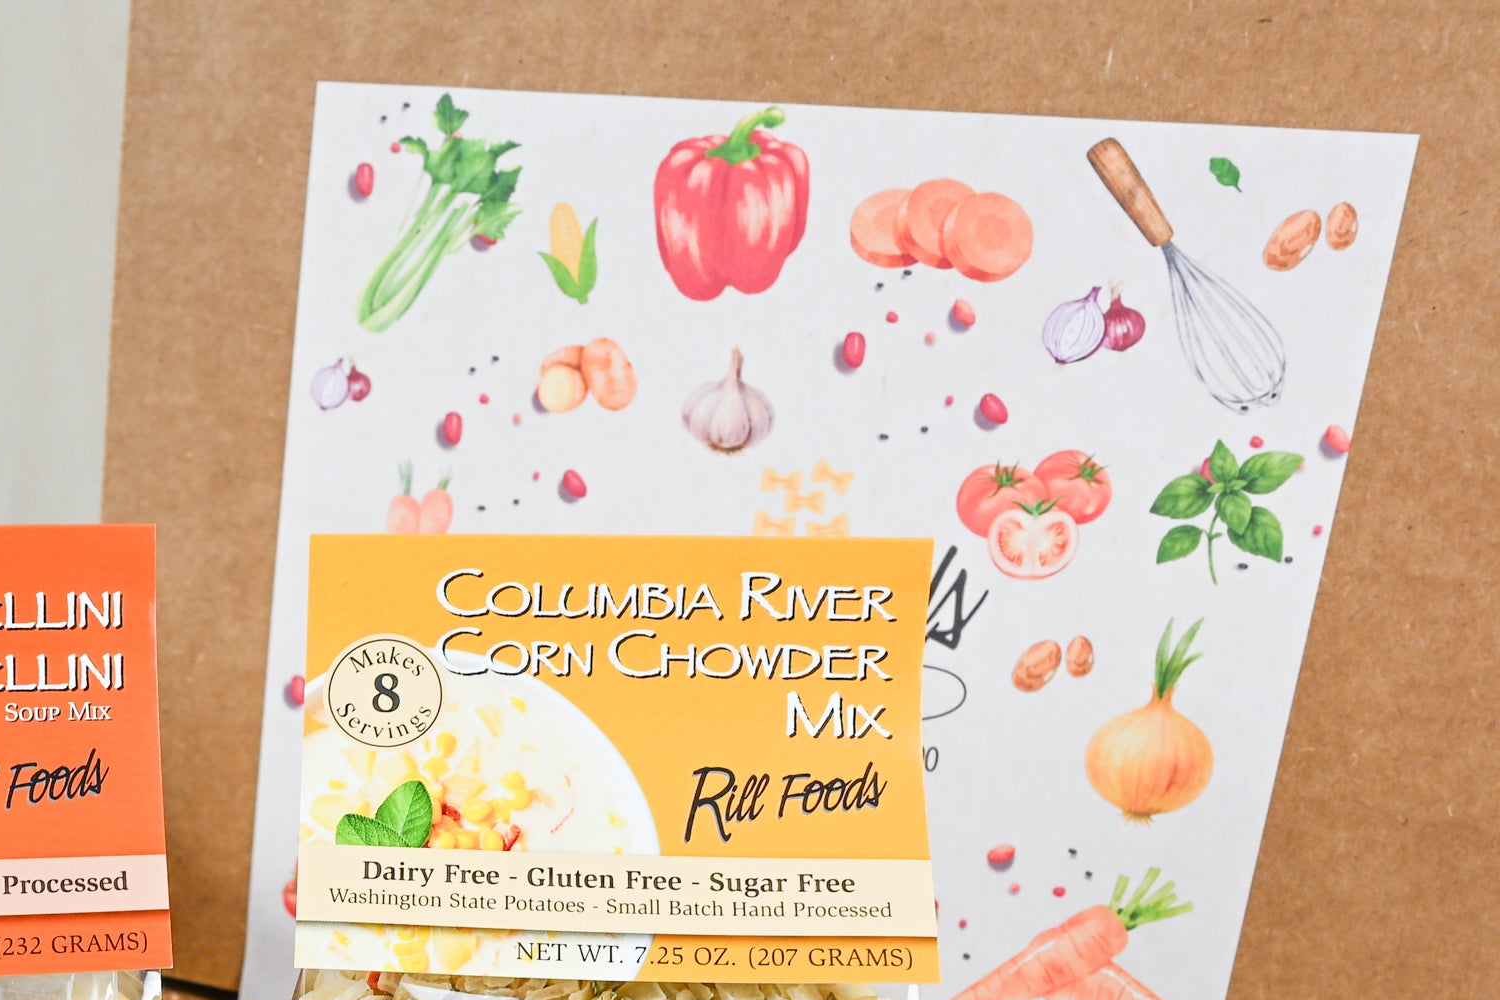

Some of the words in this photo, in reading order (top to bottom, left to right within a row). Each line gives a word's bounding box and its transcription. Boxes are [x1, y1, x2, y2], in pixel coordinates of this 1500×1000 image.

[436, 568, 723, 620] COLUMBIA
[740, 571, 896, 622] RIVER
[347, 647, 426, 679] Makes
[434, 627, 593, 677] CORN
[608, 629, 892, 682] CHOWDER
[4, 702, 62, 723] SOUP
[67, 701, 112, 722] MIX
[371, 672, 401, 713] 8
[336, 700, 434, 741] Servings
[785, 692, 892, 739] MIX
[6, 748, 108, 809] Foods
[685, 765, 764, 843] Rill
[780, 762, 888, 817] Foods
[2, 871, 129, 896] Processed
[362, 860, 435, 888] Dairy
[444, 864, 500, 887] Free
[526, 866, 616, 891] Gluten
[626, 869, 682, 891] Free
[708, 872, 788, 898] Sugar
[798, 873, 856, 894] Free
[329, 887, 442, 912] Washington
[449, 891, 496, 911] State
[504, 893, 586, 914] Potatoes
[606, 895, 661, 917] Small
[668, 897, 723, 918] Batch
[733, 898, 784, 919] Hand
[792, 898, 893, 920] Processed
[52, 930, 150, 956] GRAMS)
[516, 941, 566, 963] NET
[577, 942, 625, 964] WT.
[634, 944, 684, 966] 7.25
[694, 945, 736, 967] OZ.
[748, 945, 796, 969] (207
[808, 947, 914, 971] GRAMS)
